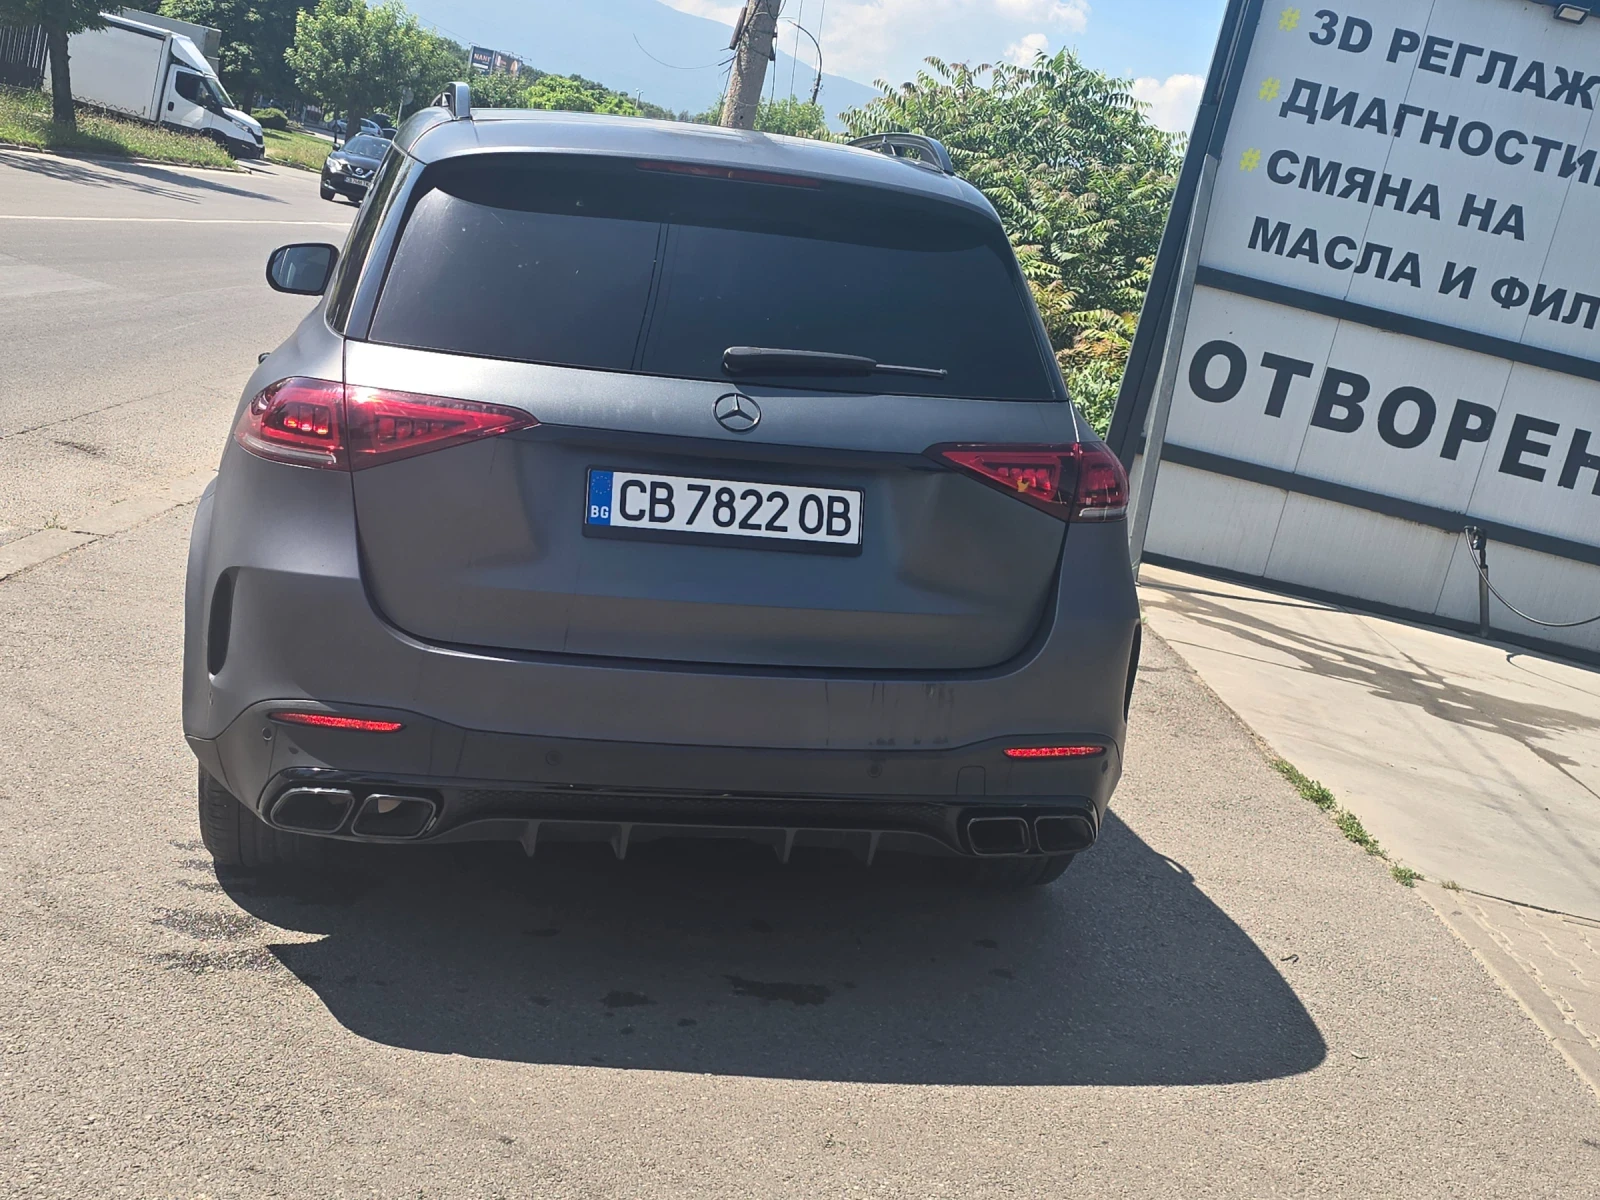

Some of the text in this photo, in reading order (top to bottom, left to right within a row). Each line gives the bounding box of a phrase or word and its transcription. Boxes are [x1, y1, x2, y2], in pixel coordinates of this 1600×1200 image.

[1308, 9, 1373, 54] 3D
[1386, 27, 1600, 111] РЕГЛАЖ
[1278, 77, 1600, 188] ДИАГНОСТИ
[1266, 149, 1441, 221] СМЯНА
[1457, 193, 1525, 241] НА
[1247, 216, 1421, 289] МАСЛА
[1437, 261, 1478, 300] И
[590, 505, 609, 518] BG
[685, 483, 790, 533] 7822
